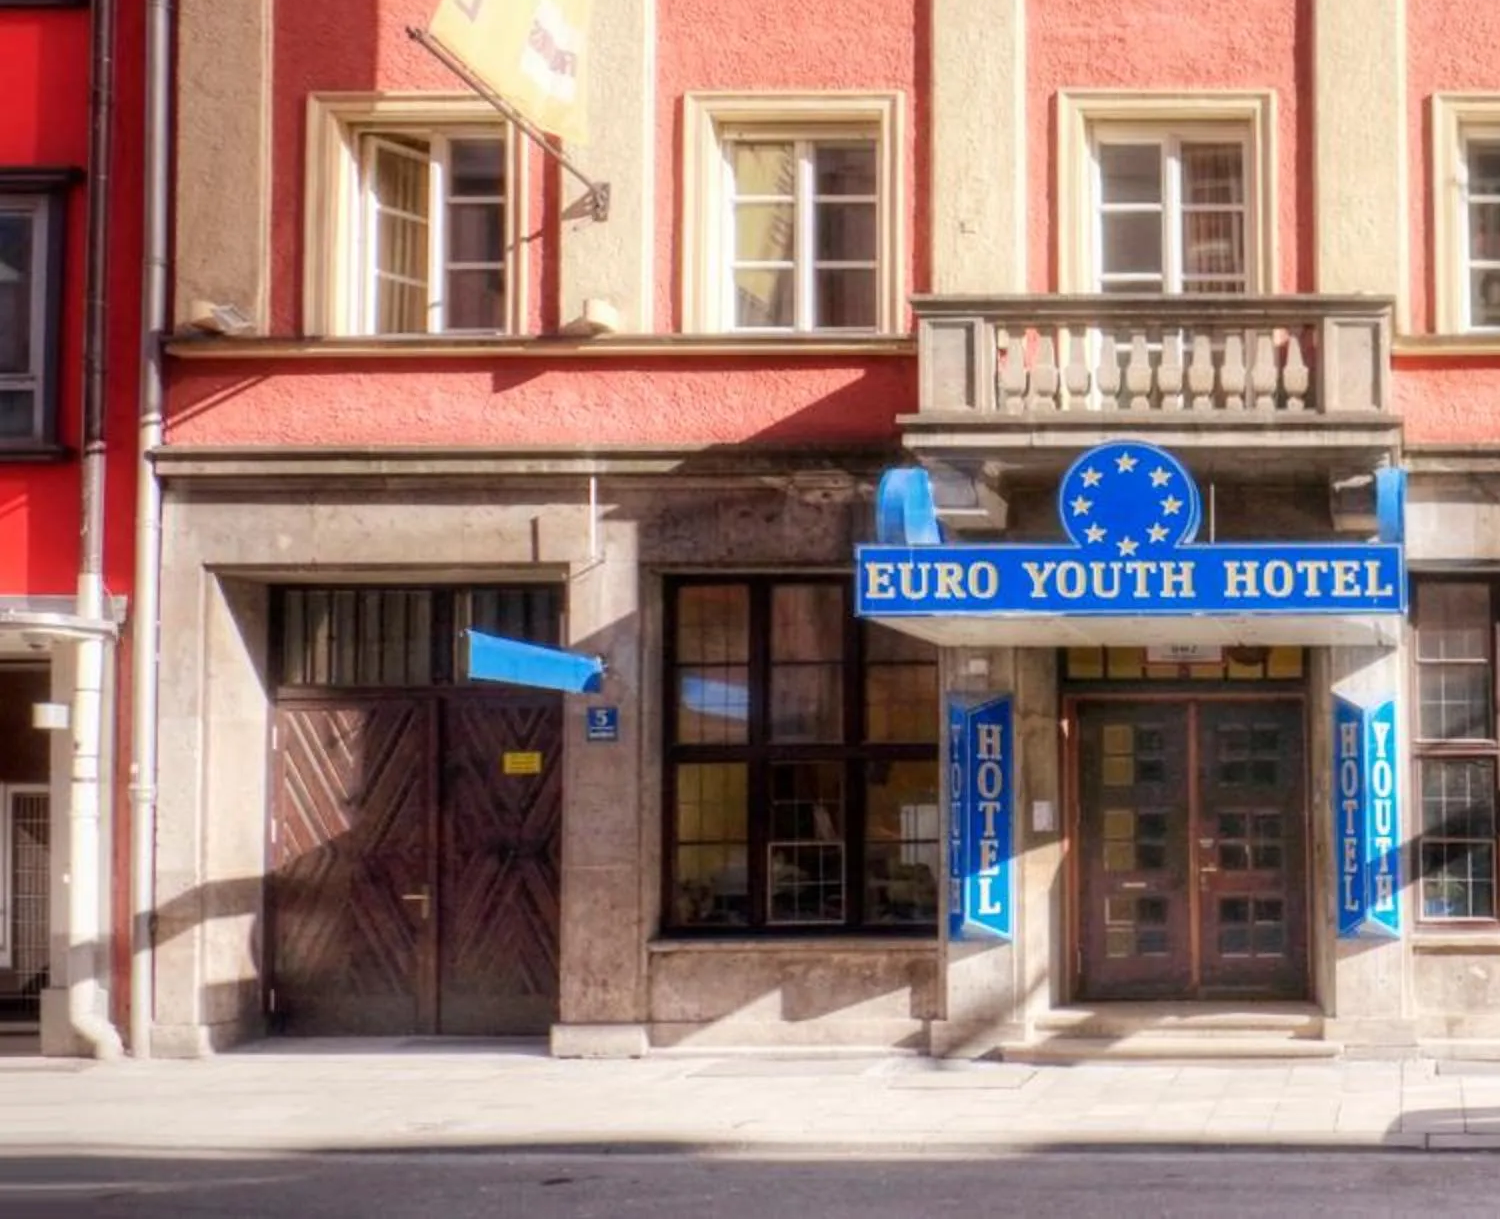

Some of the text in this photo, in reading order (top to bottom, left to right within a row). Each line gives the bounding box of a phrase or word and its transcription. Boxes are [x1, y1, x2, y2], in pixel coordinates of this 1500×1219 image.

[865, 560, 1394, 600] EURO YOUTH HOTEL
[595, 709, 608, 727] 5
[975, 723, 1003, 915] HOTEL
[1340, 721, 1360, 911] HOTEL
[1371, 720, 1395, 912] YOUTH
